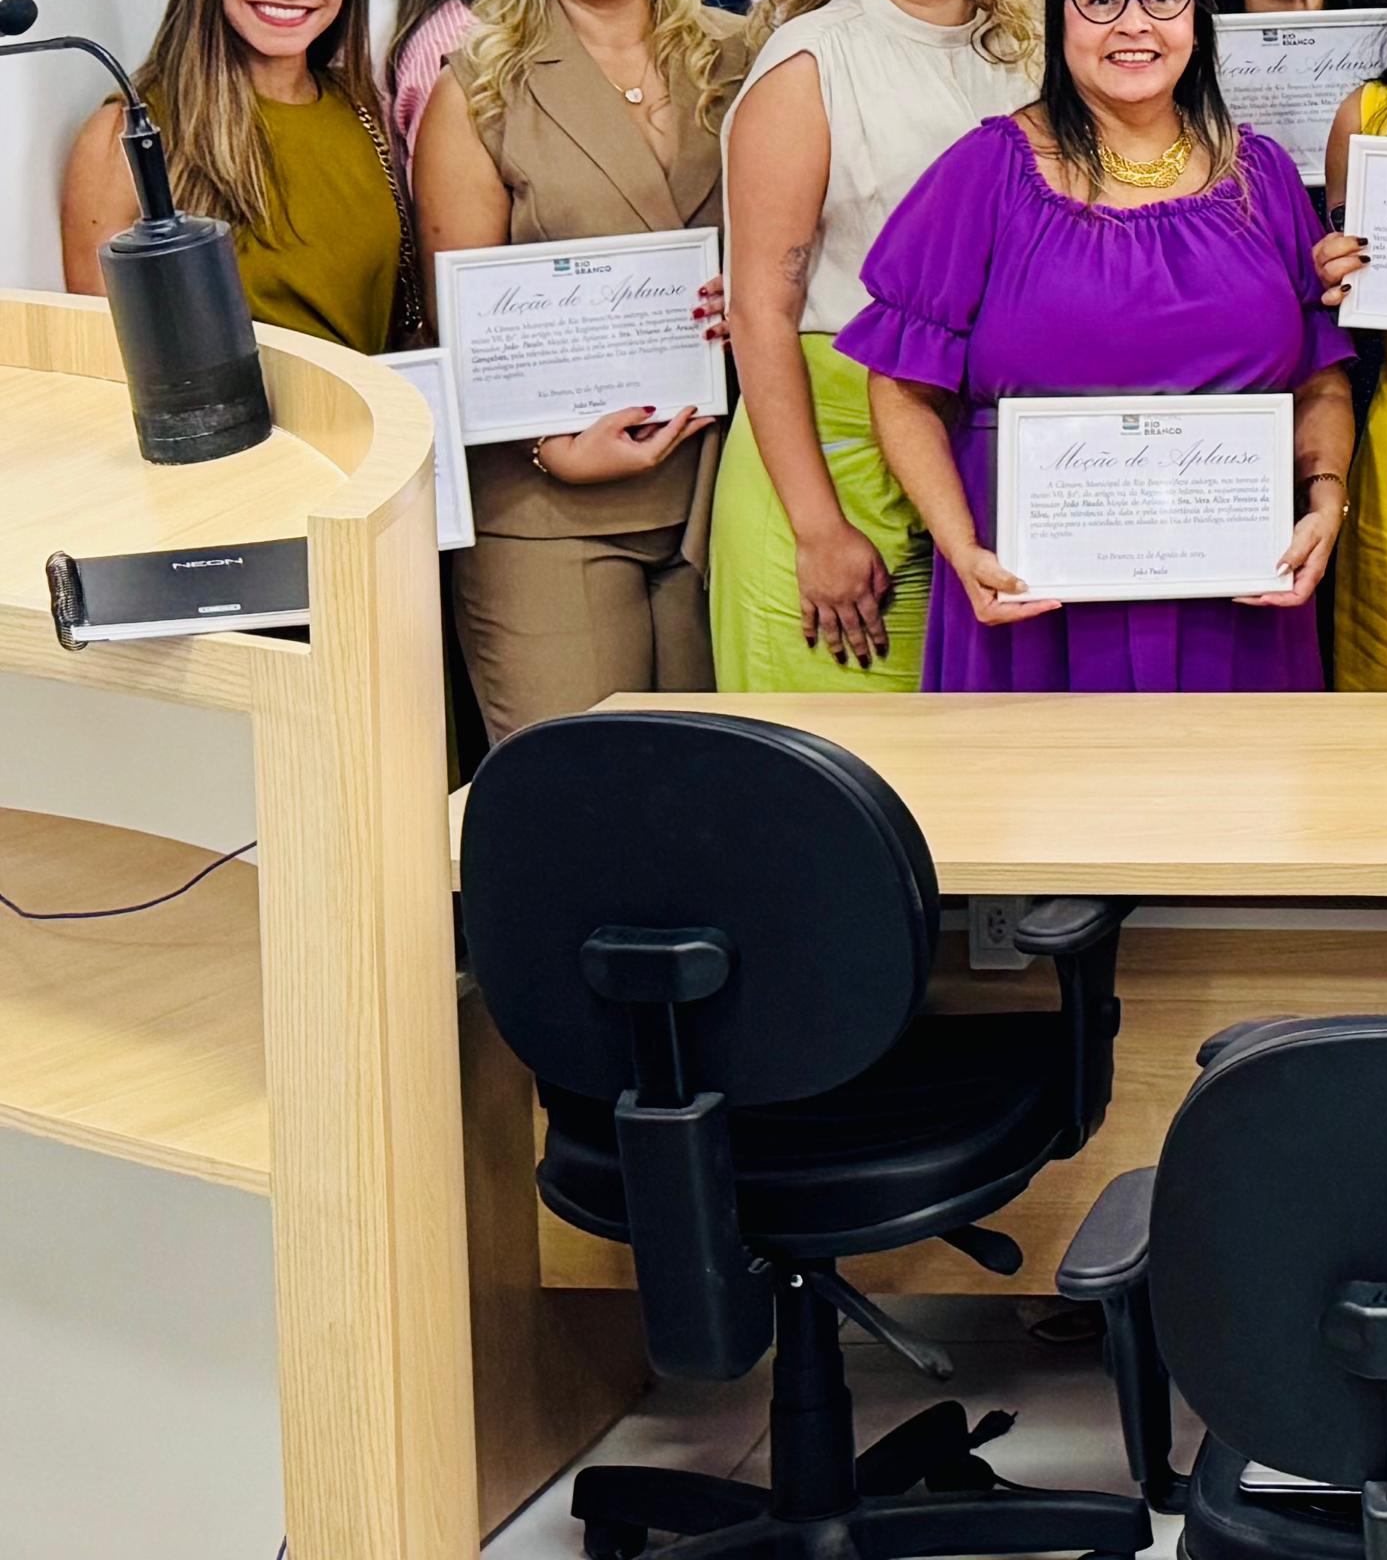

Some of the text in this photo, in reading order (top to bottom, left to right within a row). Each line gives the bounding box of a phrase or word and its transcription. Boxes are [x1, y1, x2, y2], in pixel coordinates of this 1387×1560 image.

[1267, 54, 1287, 73] de
[575, 265, 611, 274] BRANCO
[477, 275, 686, 317] Moção de Aplauso
[1040, 439, 1259, 476] Moção de Aplauso
[172, 557, 244, 571] NEON
